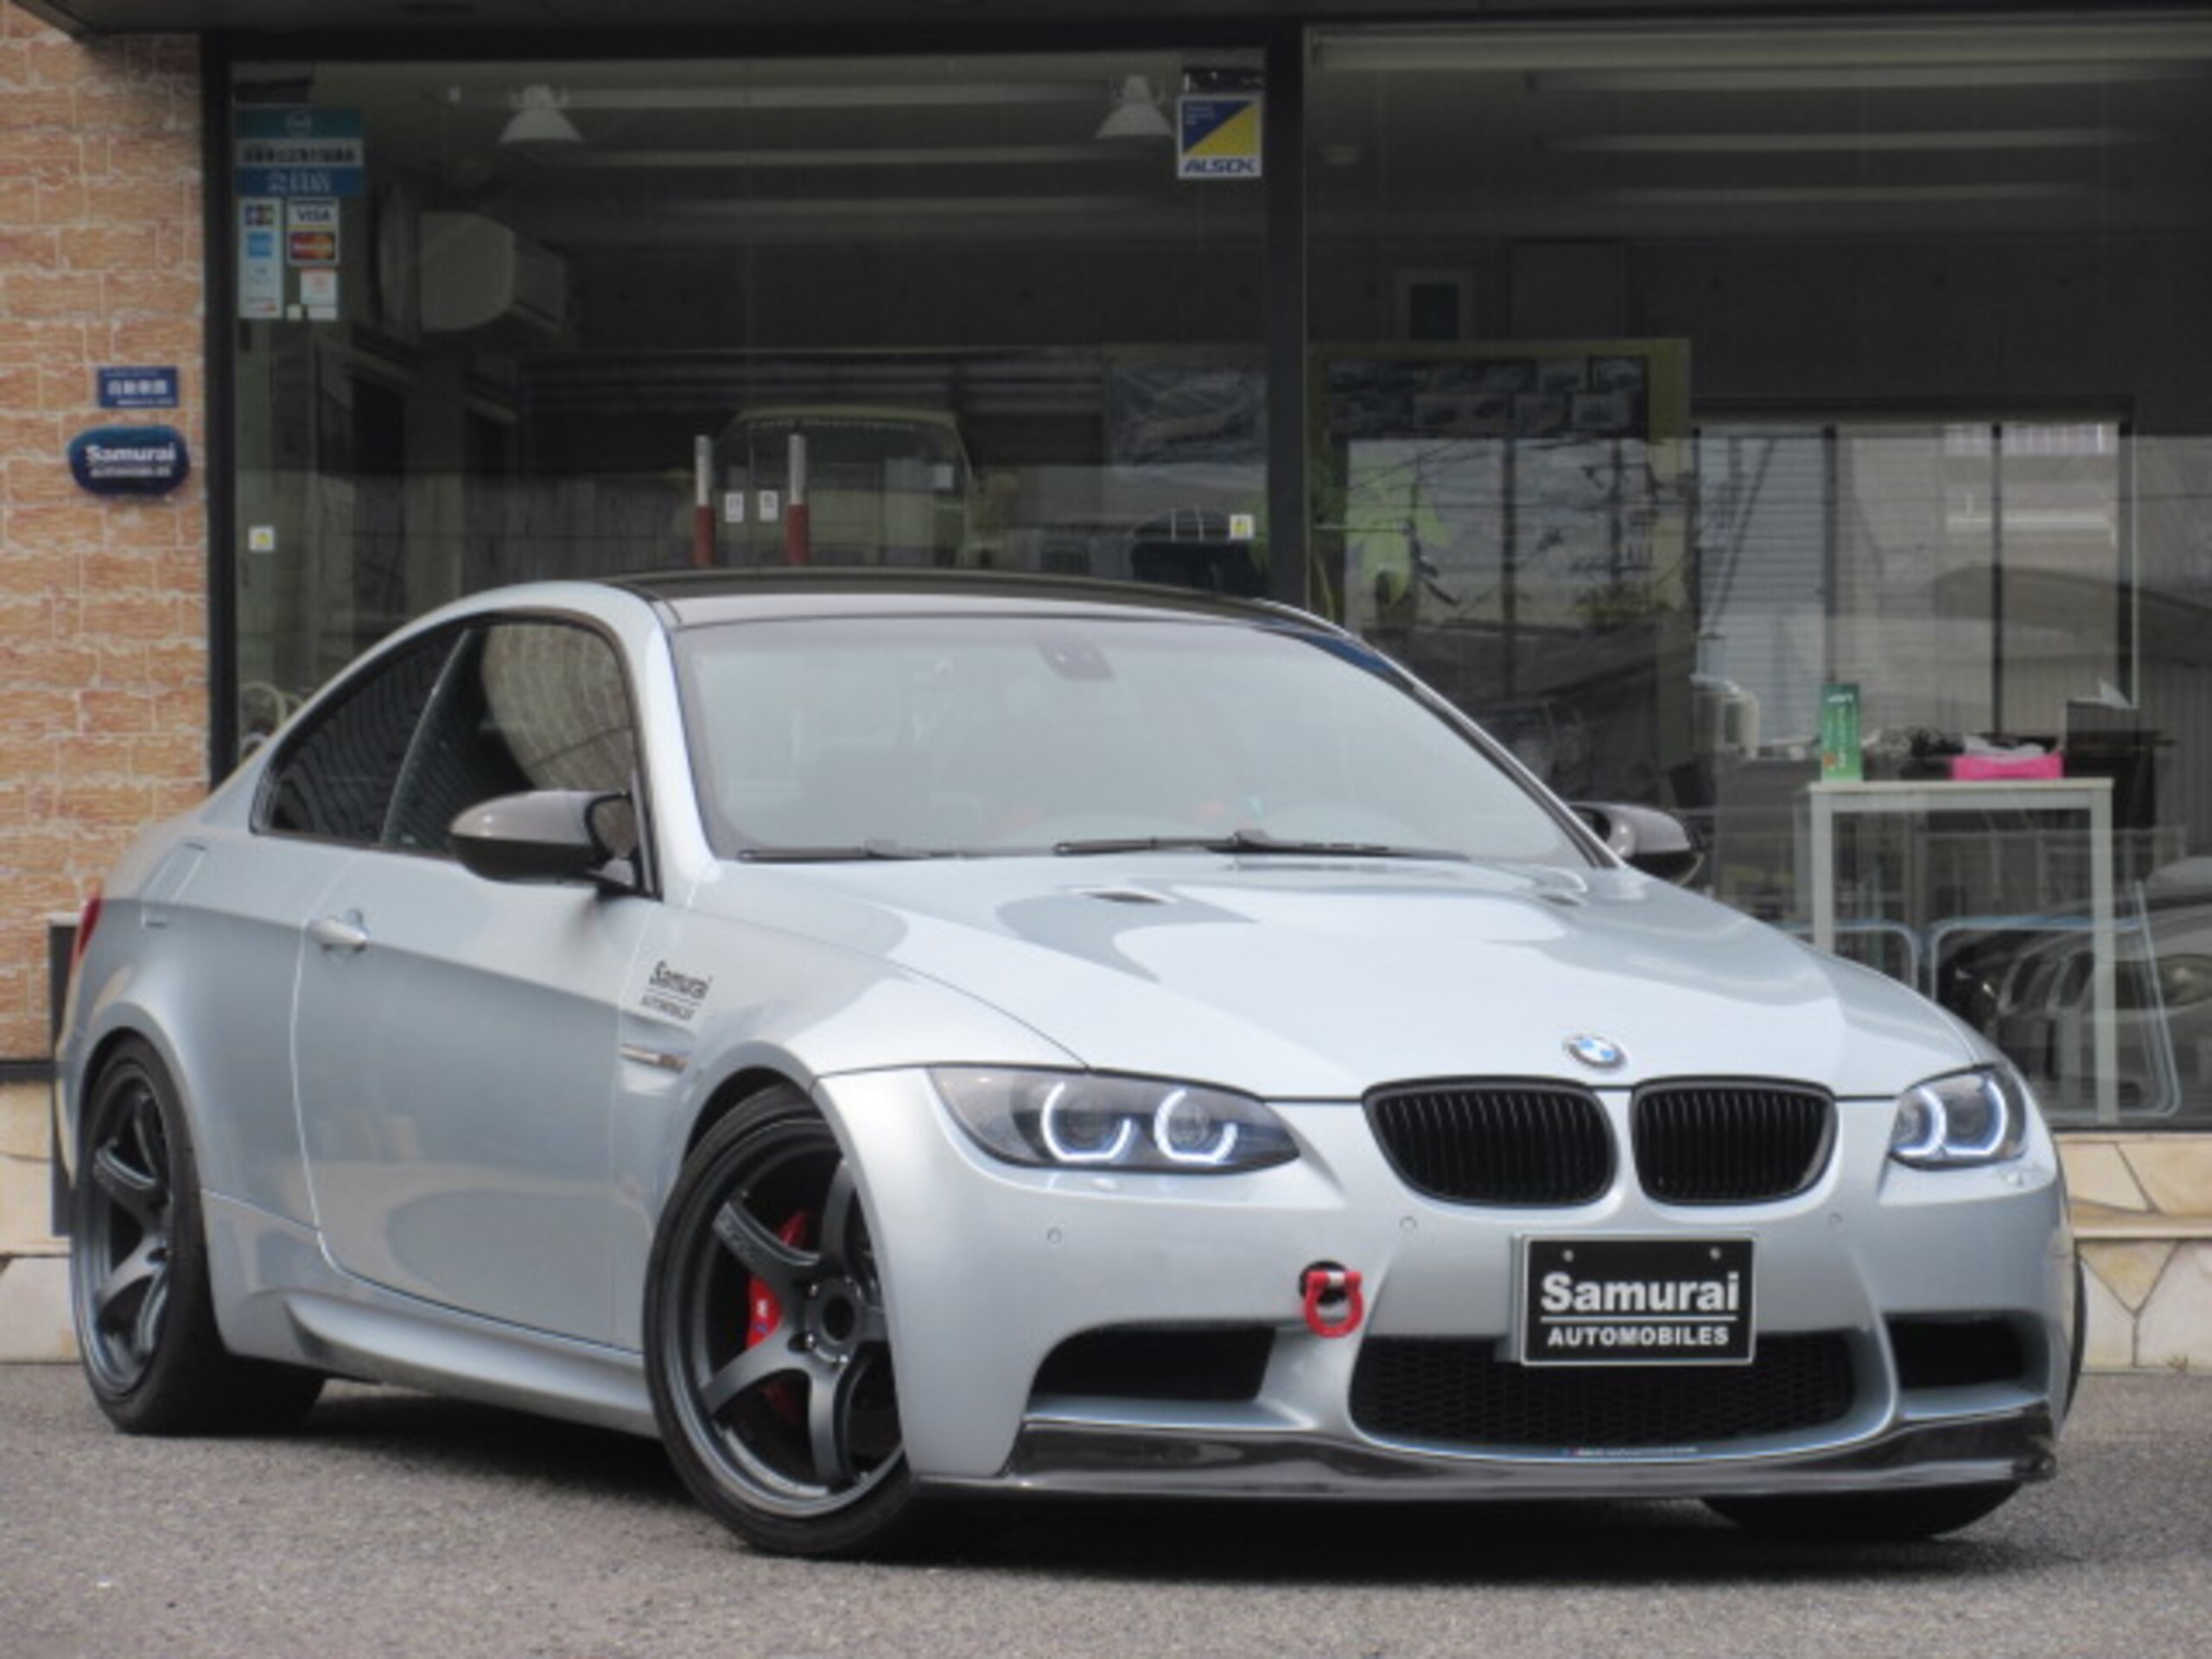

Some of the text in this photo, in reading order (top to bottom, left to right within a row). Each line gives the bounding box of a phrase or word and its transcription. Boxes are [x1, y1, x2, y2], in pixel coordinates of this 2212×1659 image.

[297, 210, 331, 222] VISA
[86, 442, 177, 461] Samurai
[649, 959, 714, 1000] Samurai
[1541, 1271, 1739, 1312] Samurai
[1548, 1326, 1729, 1346] AUTOMOBILES
